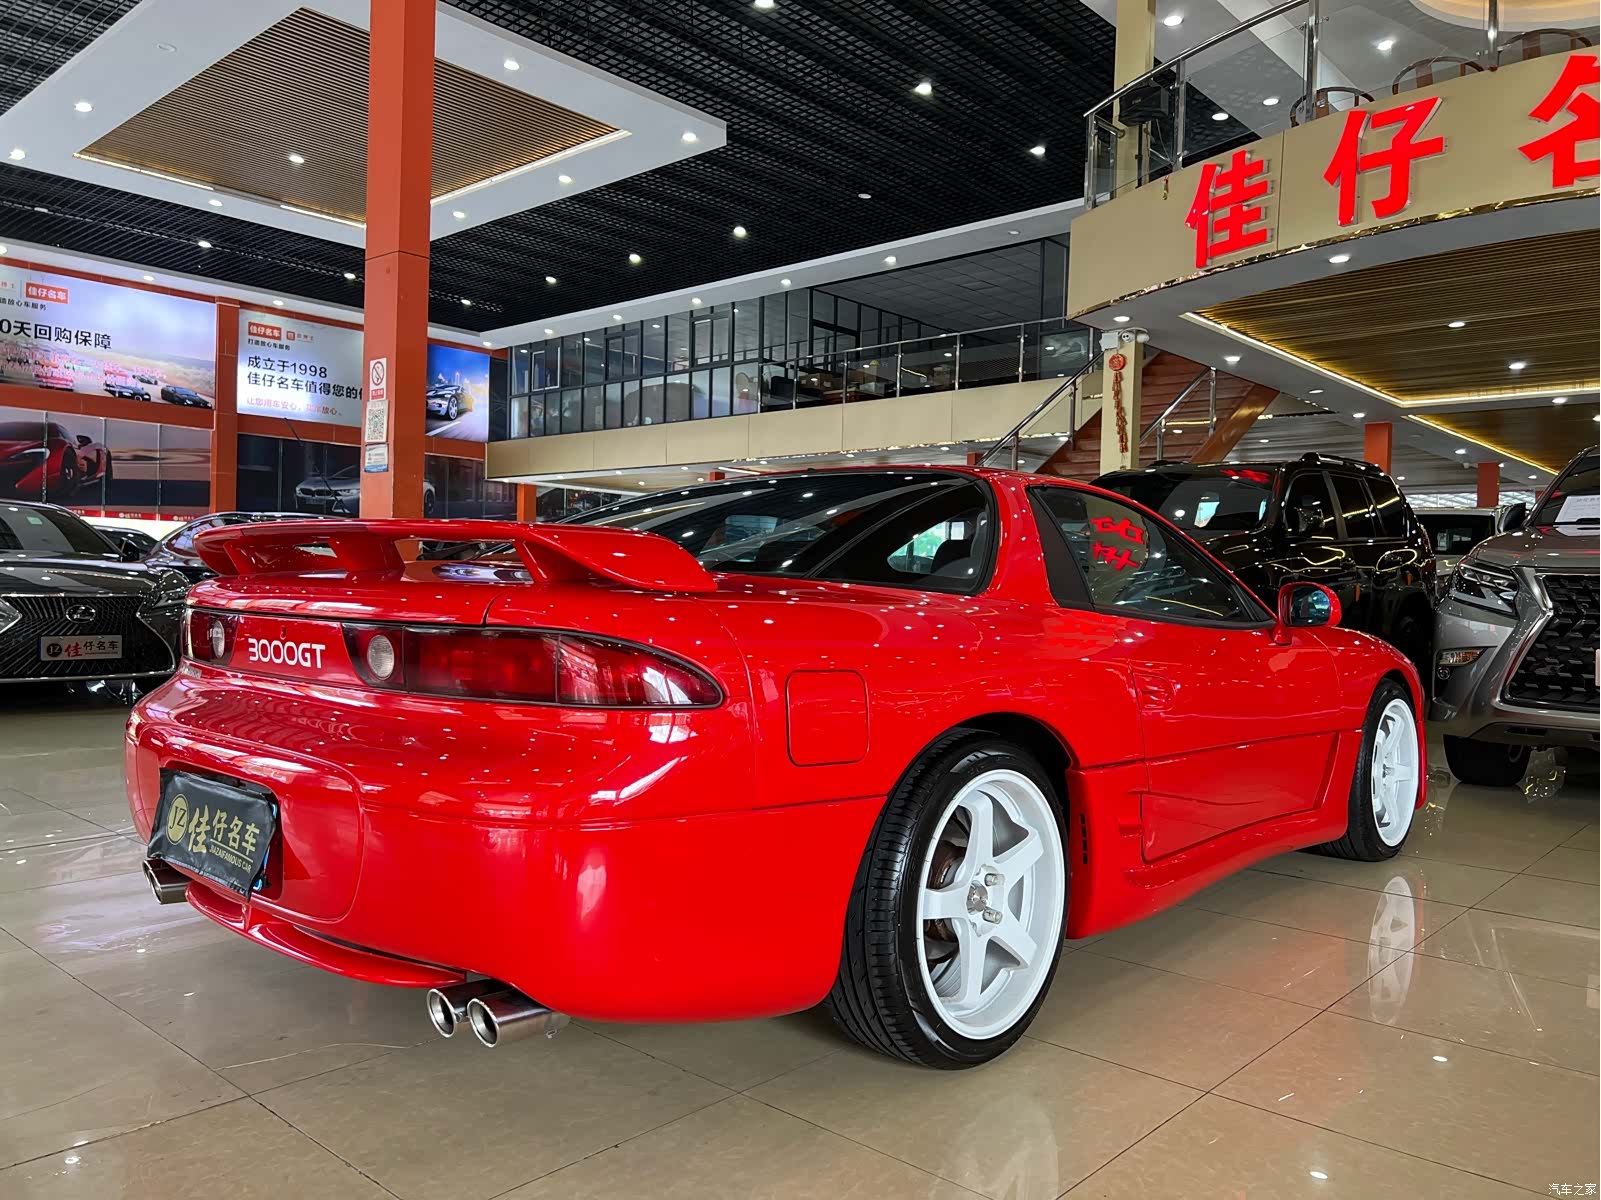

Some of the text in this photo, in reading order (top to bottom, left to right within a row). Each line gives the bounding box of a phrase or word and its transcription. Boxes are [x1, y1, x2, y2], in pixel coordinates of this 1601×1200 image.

[249, 324, 281, 338] 佳仔名车
[247, 355, 328, 379] 成立于1998
[64, 640, 119, 658] 佳仔名车
[248, 638, 326, 669] 3000GT
[169, 805, 187, 830] JZ
[188, 804, 261, 856] 佳仔名车
[241, 860, 252, 874] CAR
